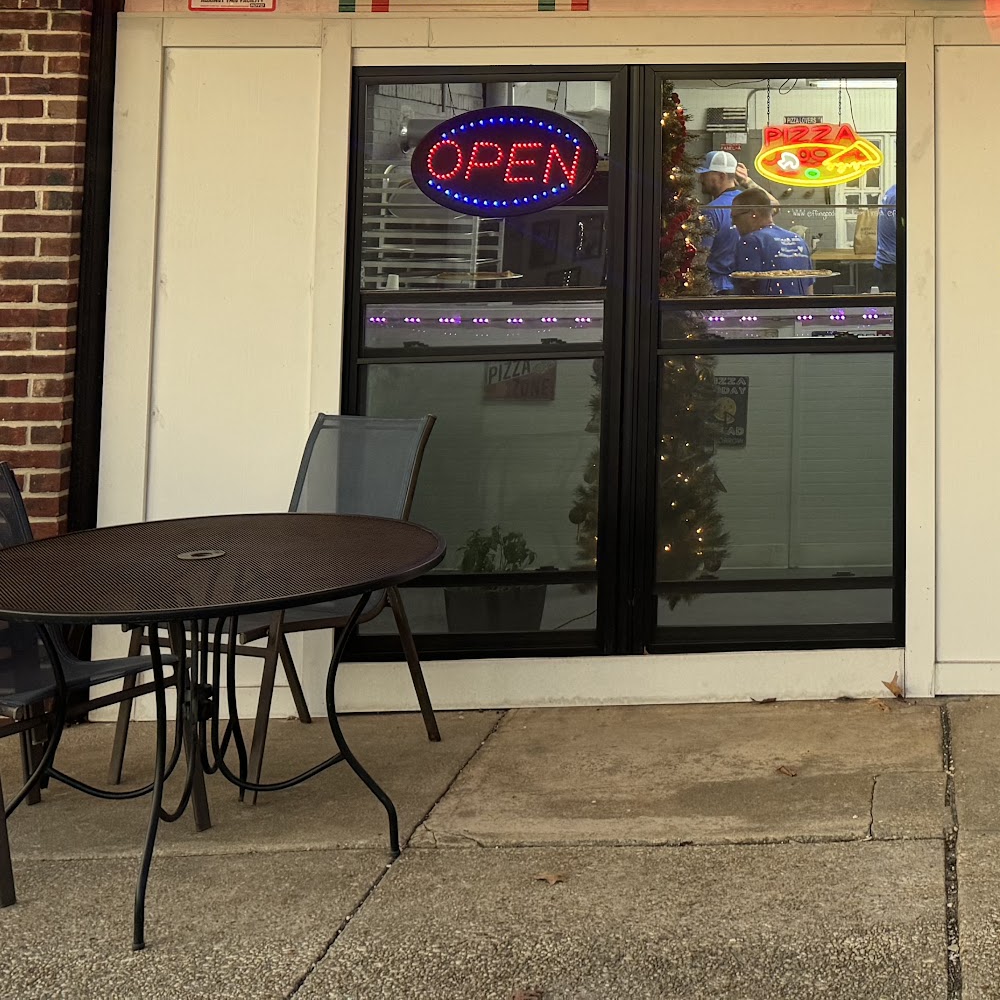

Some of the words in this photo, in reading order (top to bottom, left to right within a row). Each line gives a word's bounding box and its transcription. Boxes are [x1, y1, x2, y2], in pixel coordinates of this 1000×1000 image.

[764, 124, 857, 147] PIZZA
[426, 138, 582, 185] OPEN
[488, 360, 531, 385] PIZZA
[713, 377, 747, 386] IZZA
